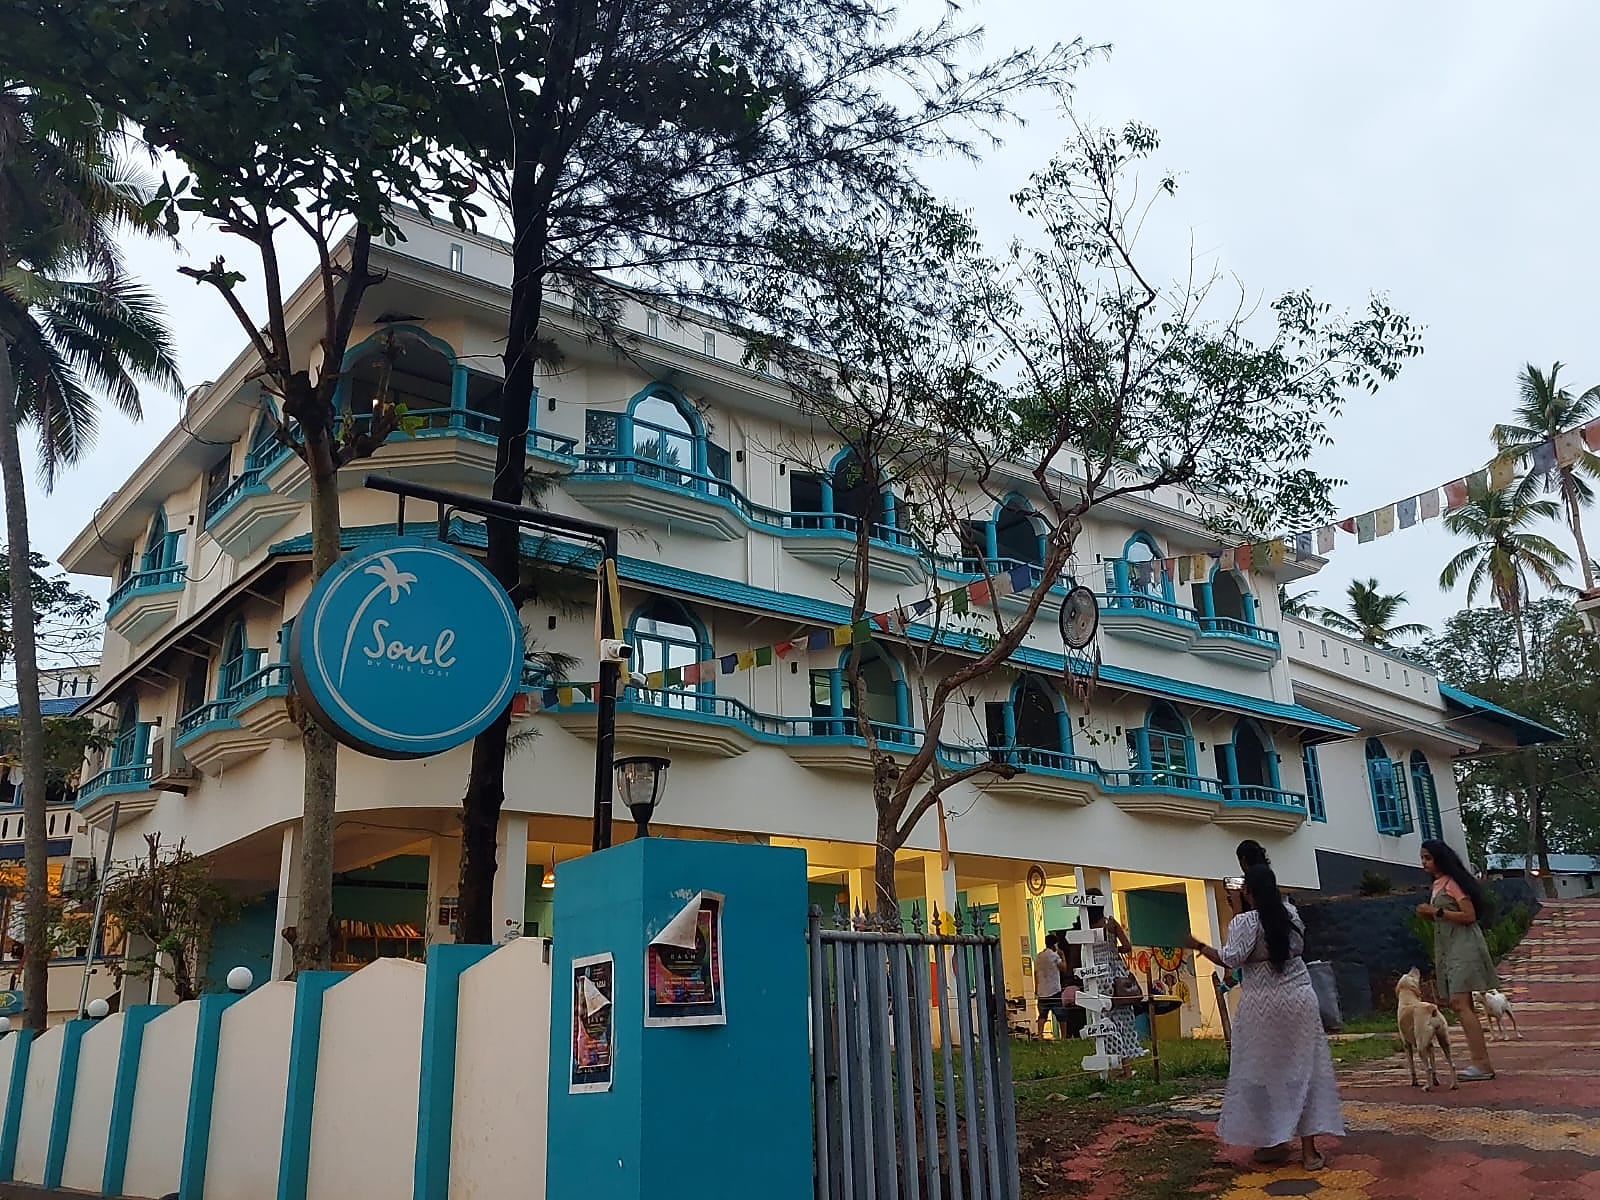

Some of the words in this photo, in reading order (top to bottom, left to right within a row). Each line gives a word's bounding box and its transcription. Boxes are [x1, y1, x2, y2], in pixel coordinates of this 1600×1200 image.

[363, 619, 457, 668] Soul
[391, 663, 412, 672] THE
[1072, 895, 1097, 905] CAFE
